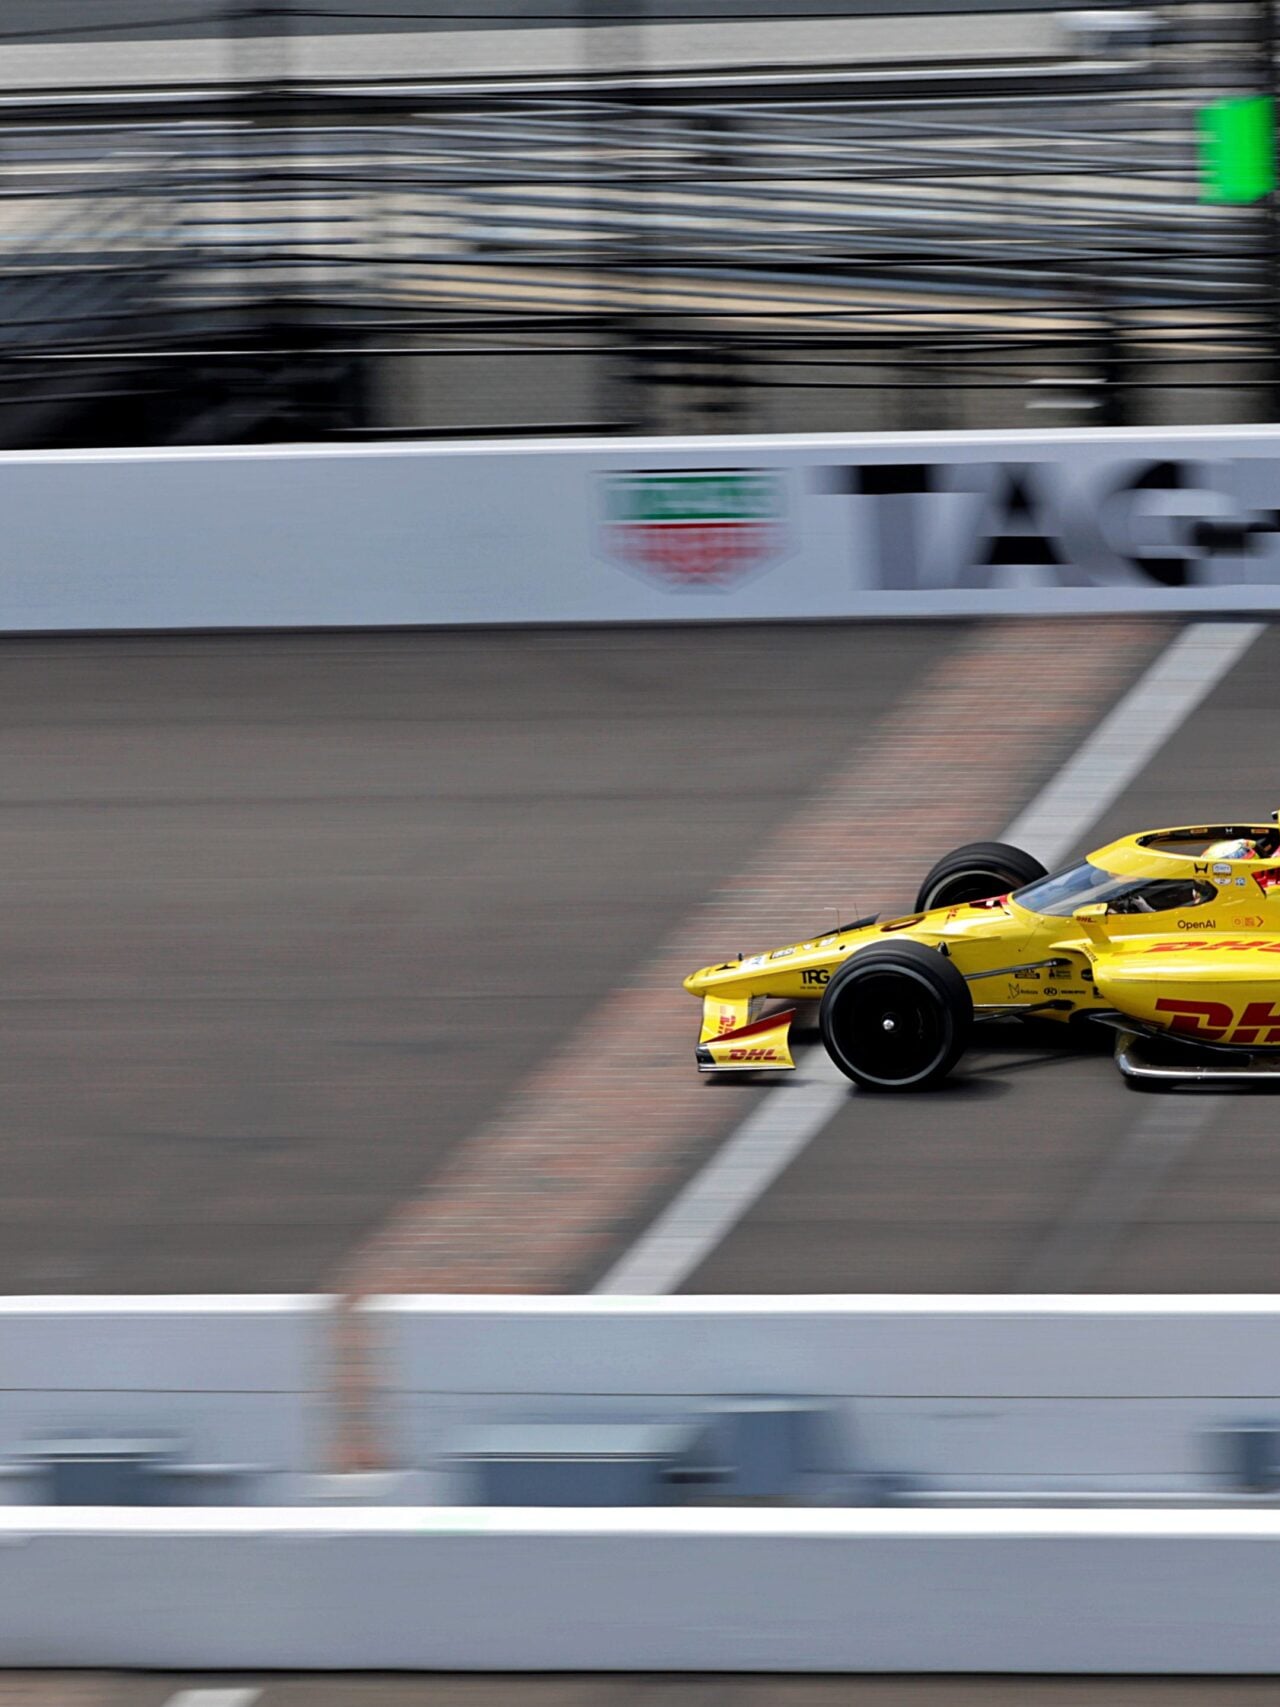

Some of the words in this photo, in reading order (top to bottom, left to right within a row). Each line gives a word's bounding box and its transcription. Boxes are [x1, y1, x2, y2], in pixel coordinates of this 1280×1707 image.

[1177, 920, 1216, 931] OpenAI
[799, 969, 830, 984] TRG
[728, 1049, 777, 1060] DHL
